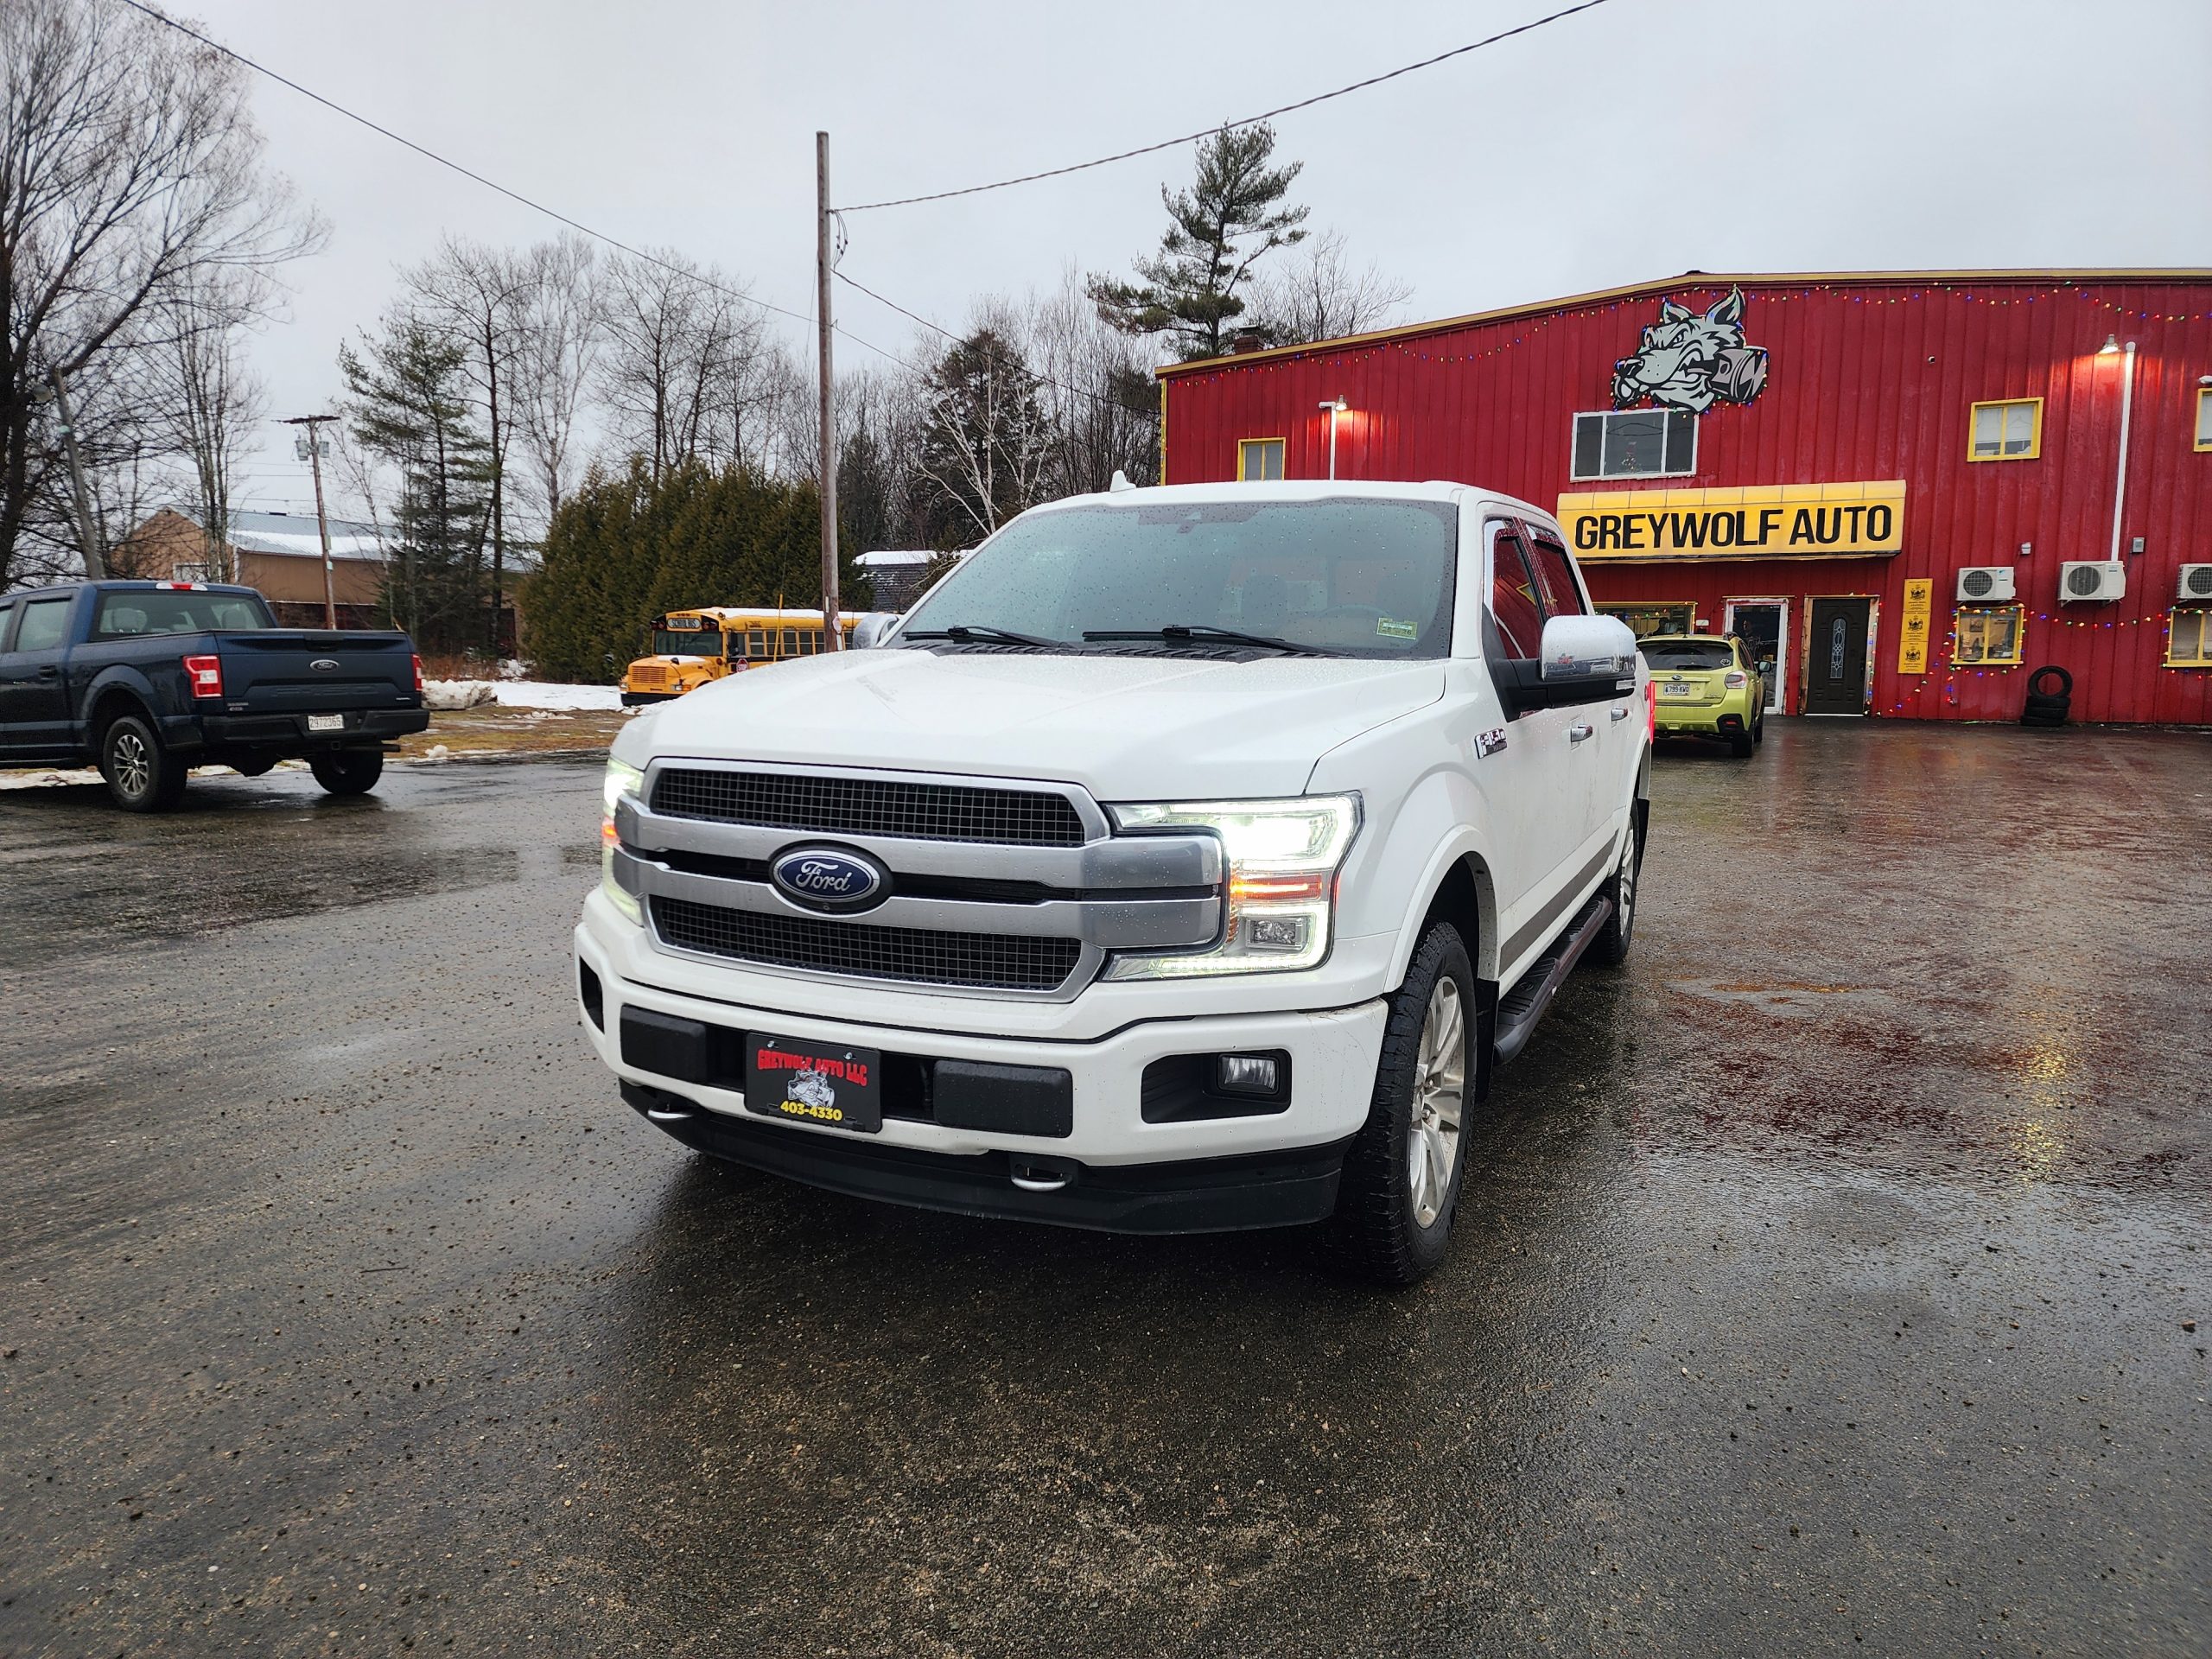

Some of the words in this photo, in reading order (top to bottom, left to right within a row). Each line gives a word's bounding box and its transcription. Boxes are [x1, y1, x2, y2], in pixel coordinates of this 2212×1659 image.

[1575, 509, 1784, 550] GREYWOLF
[1789, 505, 1892, 545] AUTO
[795, 860, 853, 892] Ford
[814, 1058, 844, 1077] AUTO
[846, 1063, 868, 1086] LLC
[780, 1100, 842, 1122] 403-4330
